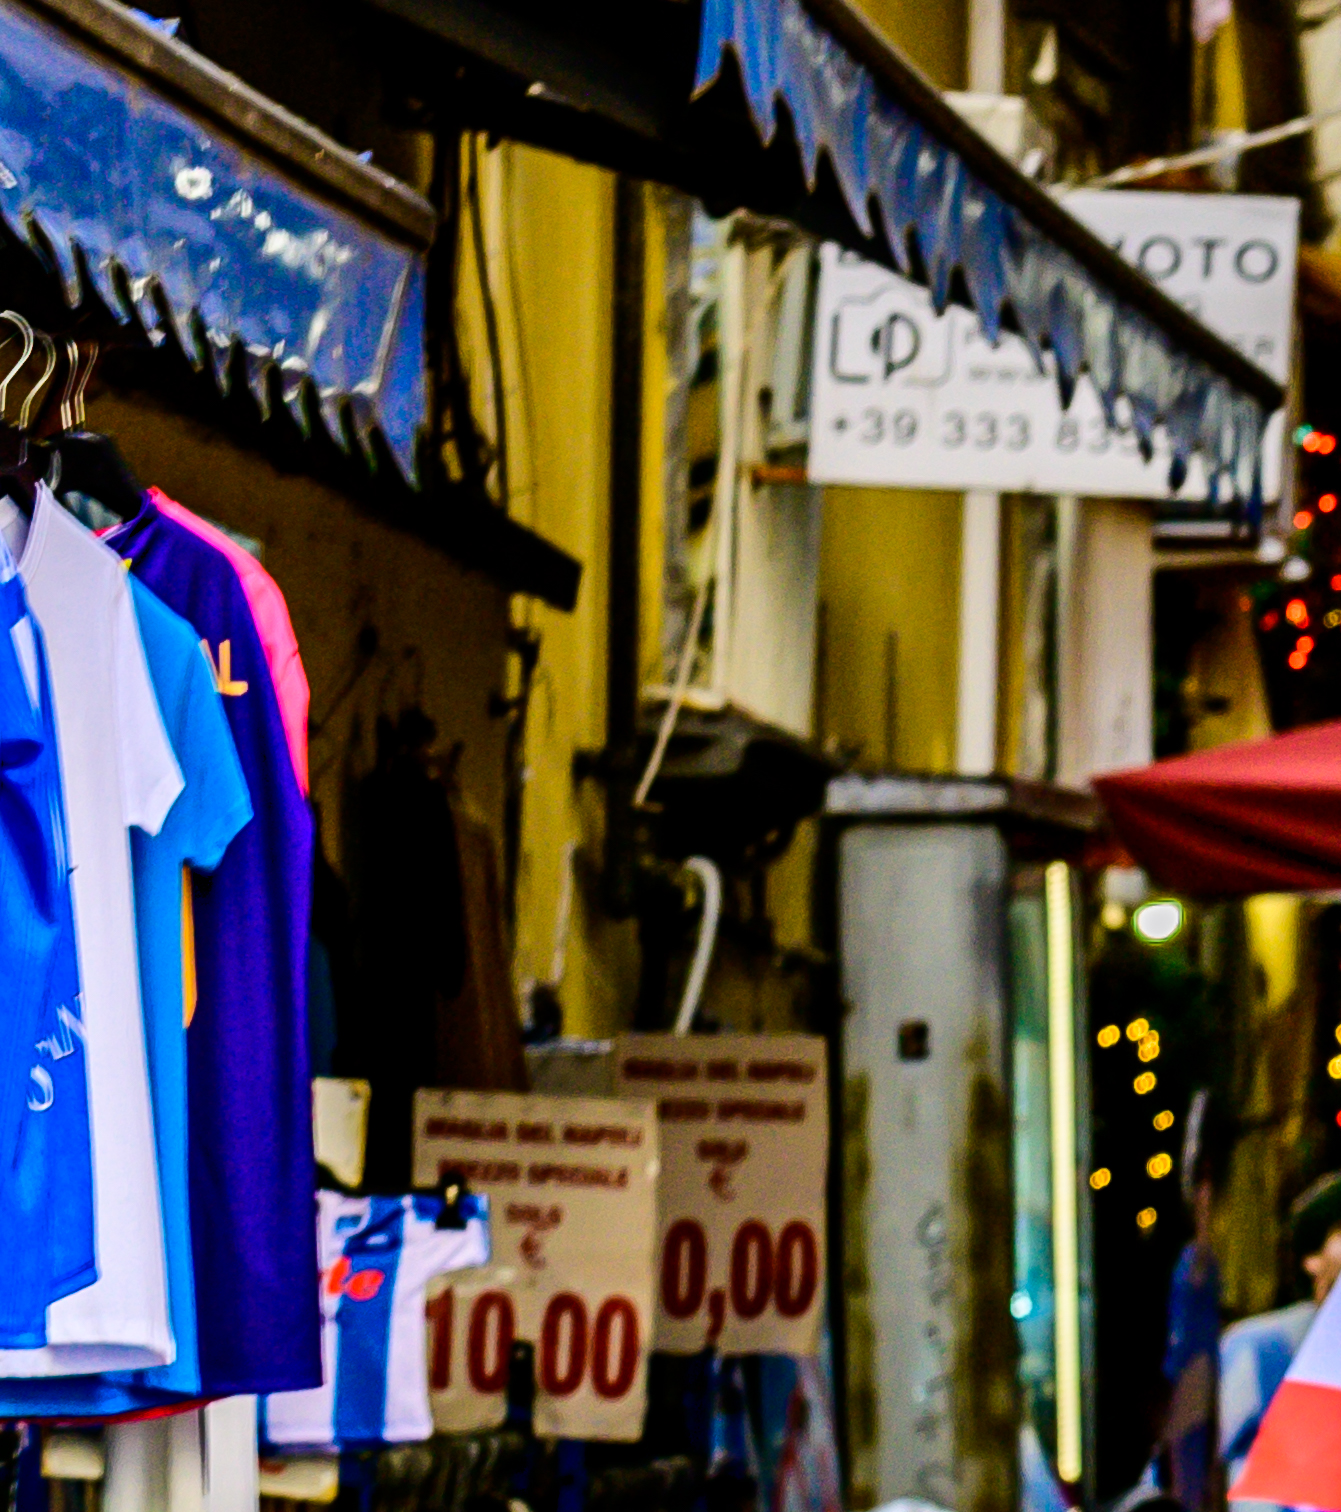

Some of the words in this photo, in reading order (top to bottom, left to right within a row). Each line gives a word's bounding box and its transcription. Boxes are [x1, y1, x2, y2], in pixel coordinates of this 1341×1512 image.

[1112, 232, 1280, 286] OTO
[832, 406, 920, 448] +39
[941, 412, 1032, 452] 333
[662, 1219, 818, 1339] 0,00
[427, 1288, 640, 1402] 1000
